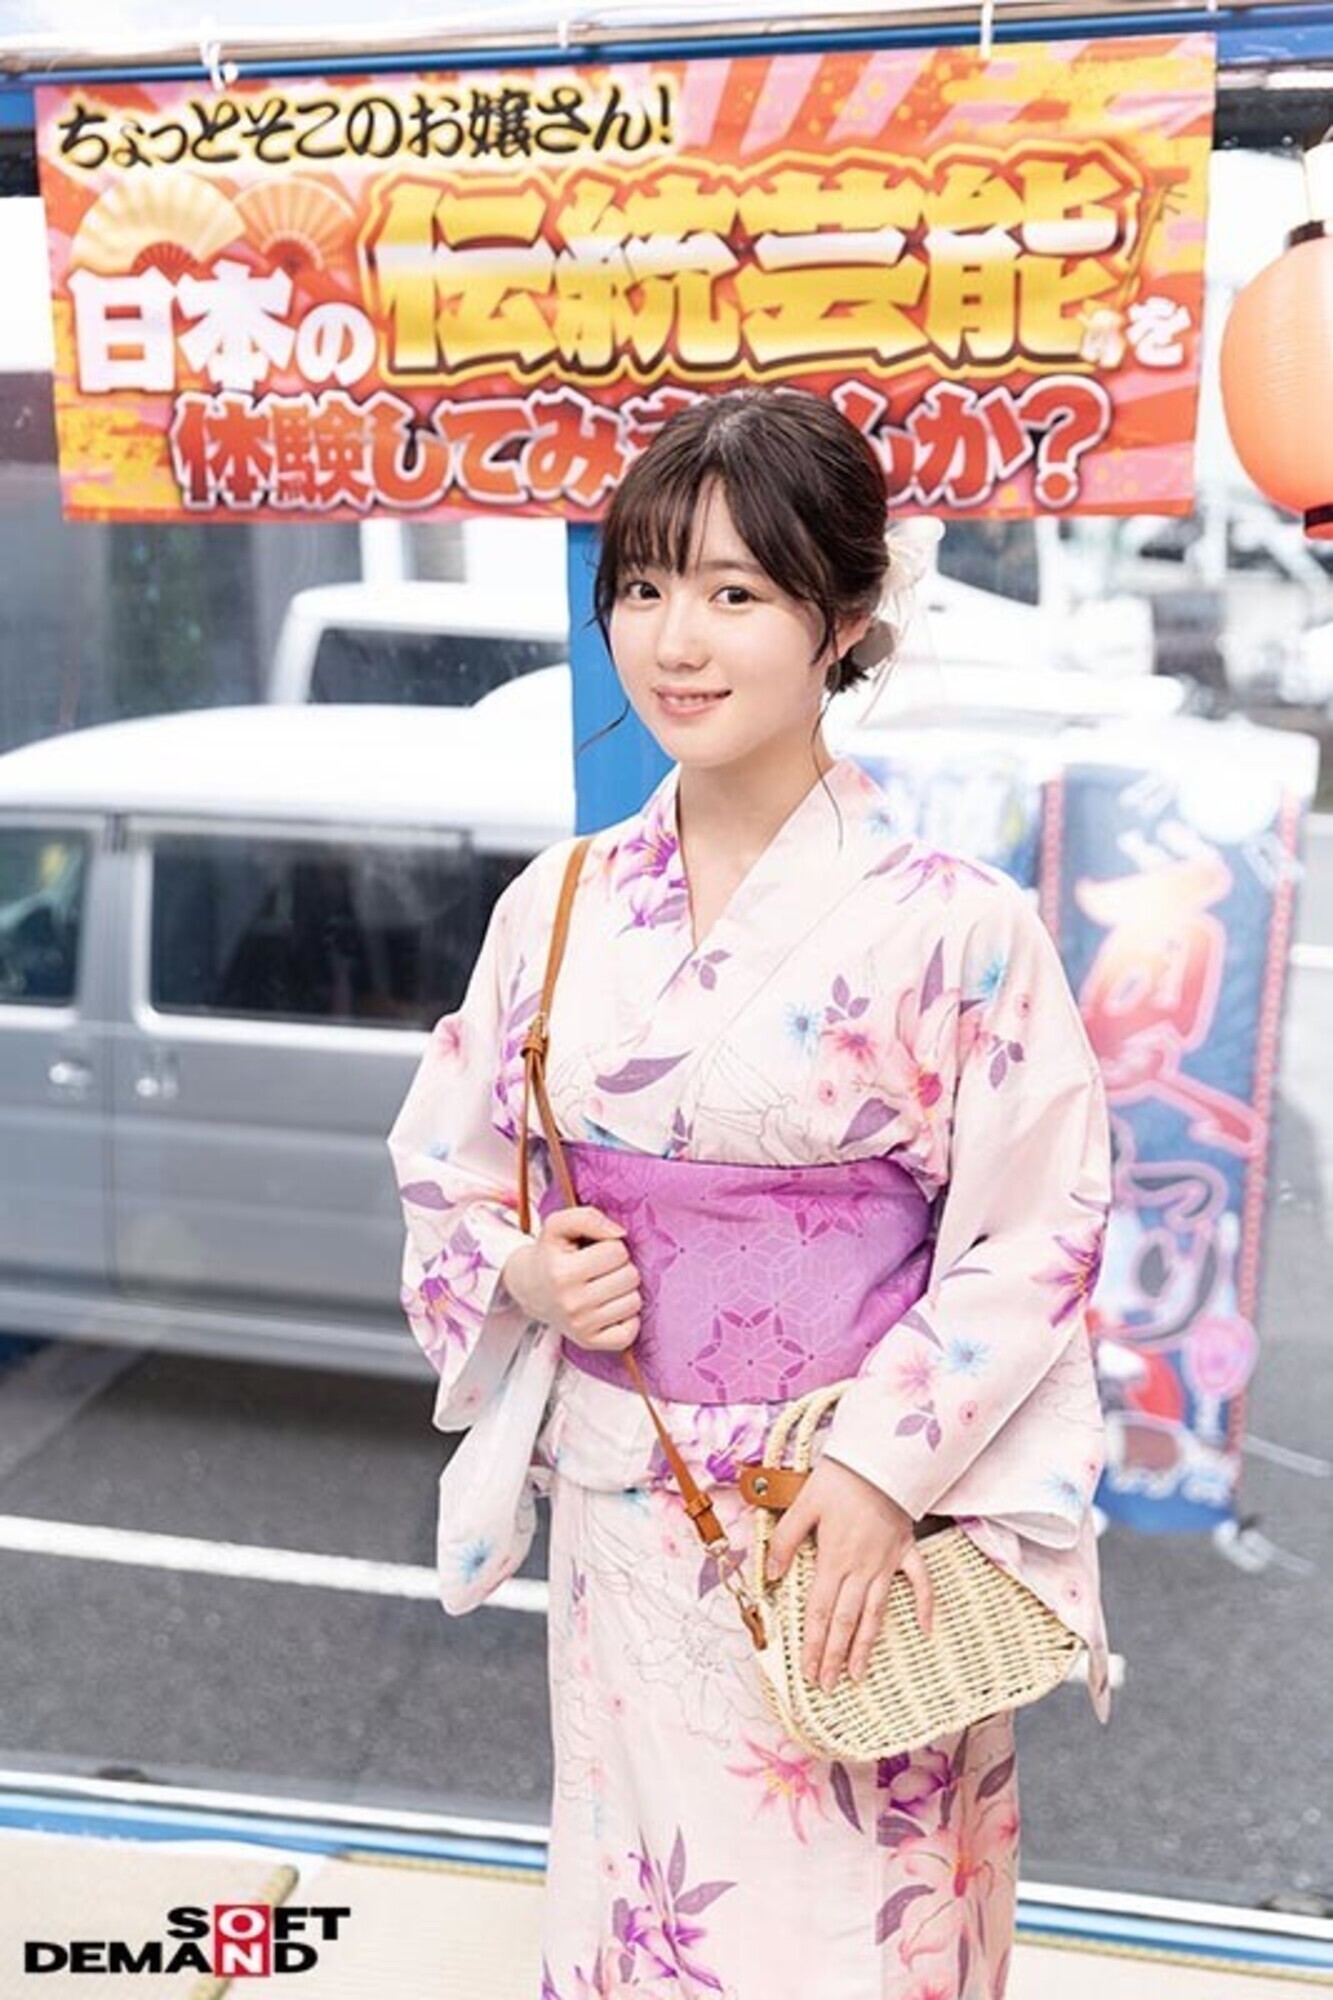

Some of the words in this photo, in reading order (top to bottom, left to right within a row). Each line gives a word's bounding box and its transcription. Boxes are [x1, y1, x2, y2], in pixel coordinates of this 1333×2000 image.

[58, 85, 672, 168] ちょっとそこのお嬢さん!
